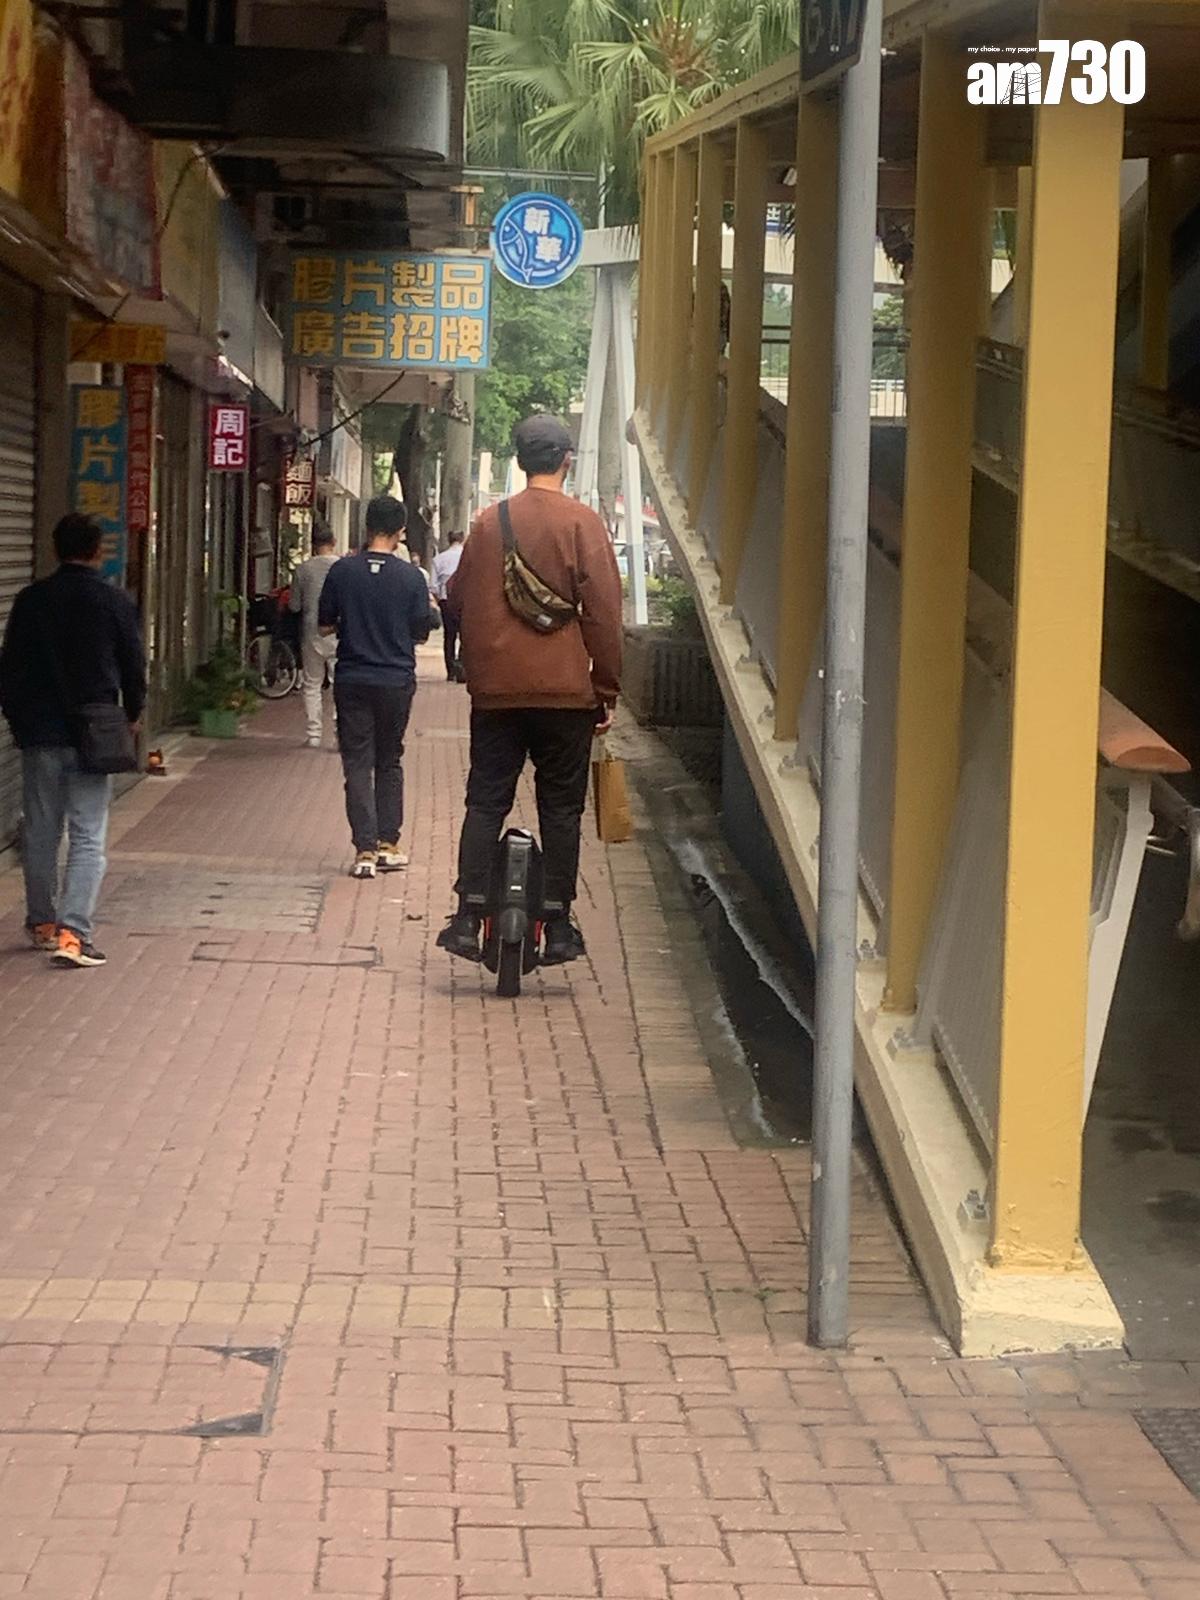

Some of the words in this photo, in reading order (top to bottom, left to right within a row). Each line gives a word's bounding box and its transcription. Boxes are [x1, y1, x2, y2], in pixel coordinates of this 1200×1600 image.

[292, 256, 484, 310] 膠片製品
[292, 310, 484, 363] 廣告招牌
[213, 409, 245, 465] 周記
